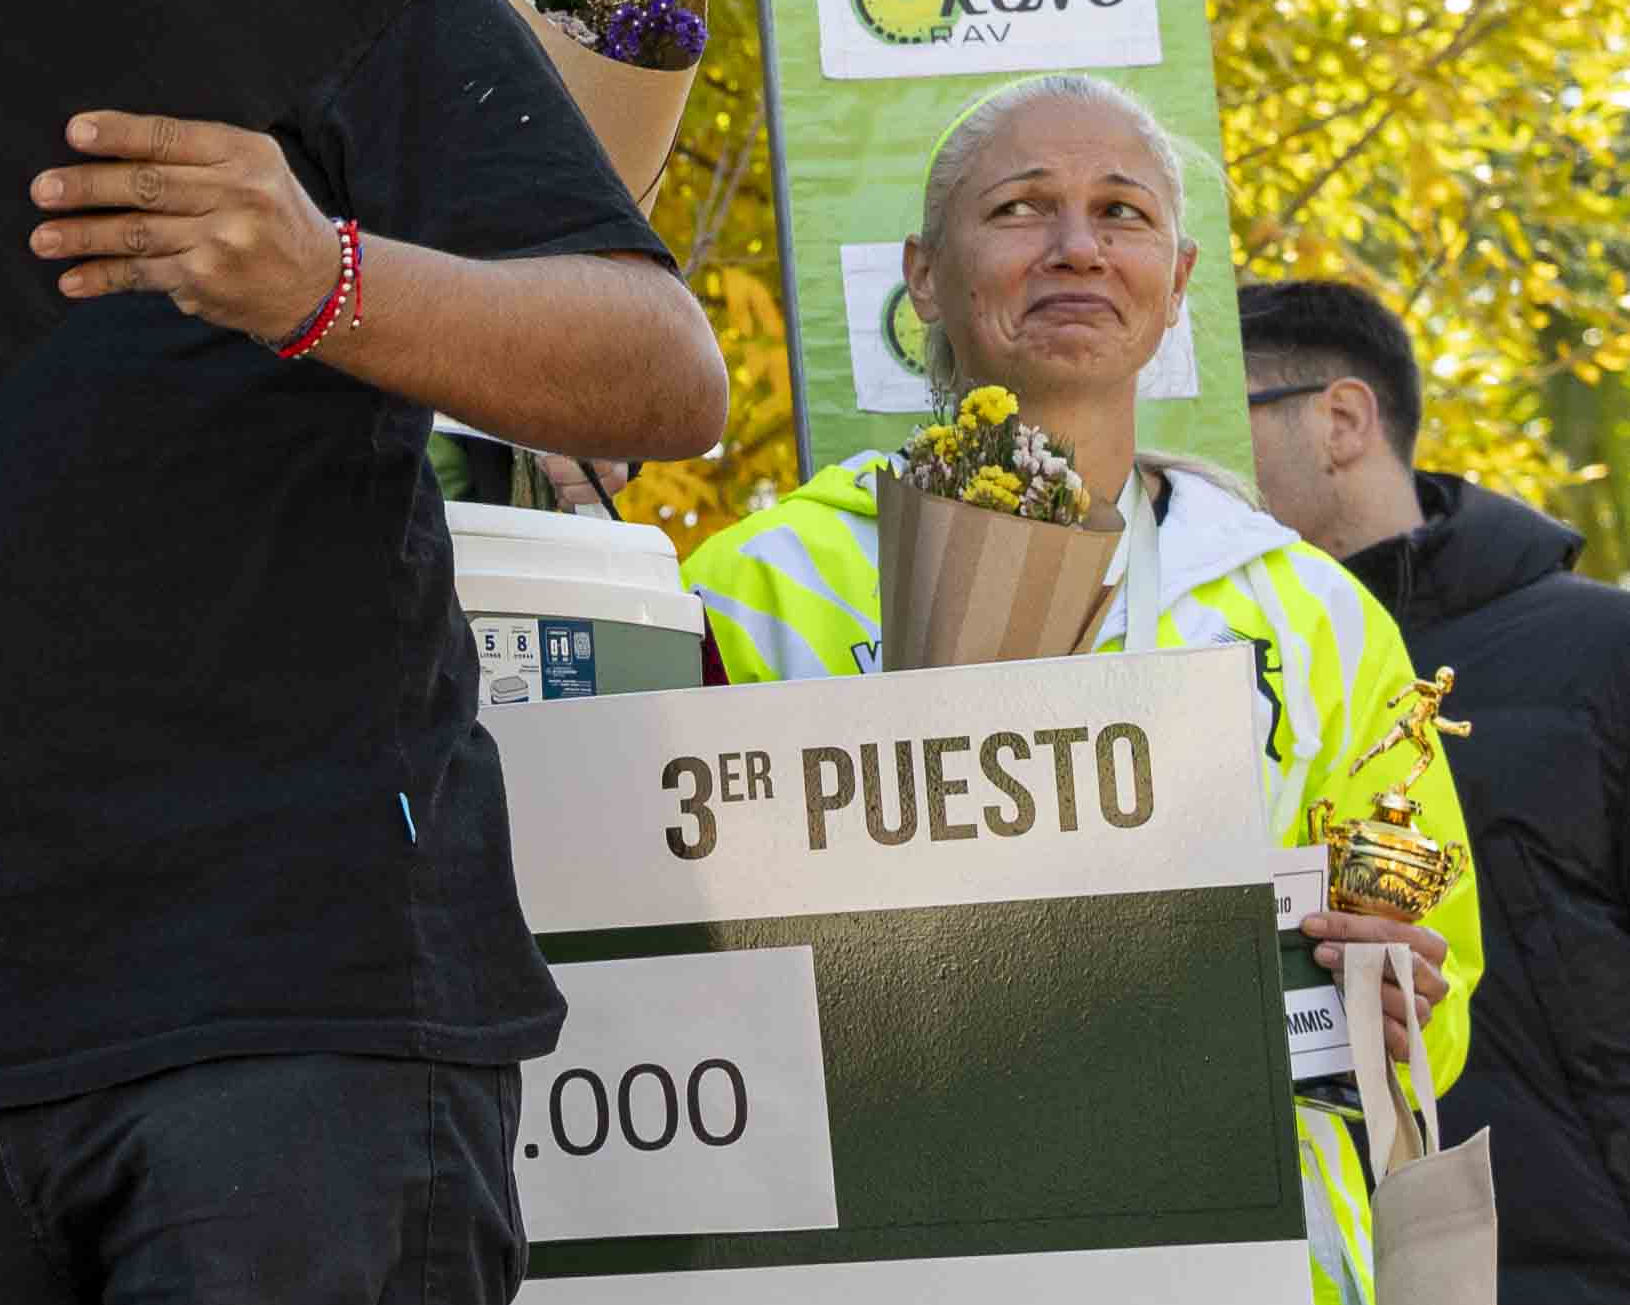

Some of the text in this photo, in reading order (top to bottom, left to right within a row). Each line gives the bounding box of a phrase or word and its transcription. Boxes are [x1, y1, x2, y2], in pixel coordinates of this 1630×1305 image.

[931, 23, 1011, 44] RAV
[801, 721, 1154, 850] PUESTO
[1287, 1008, 1334, 1036] MMIS
